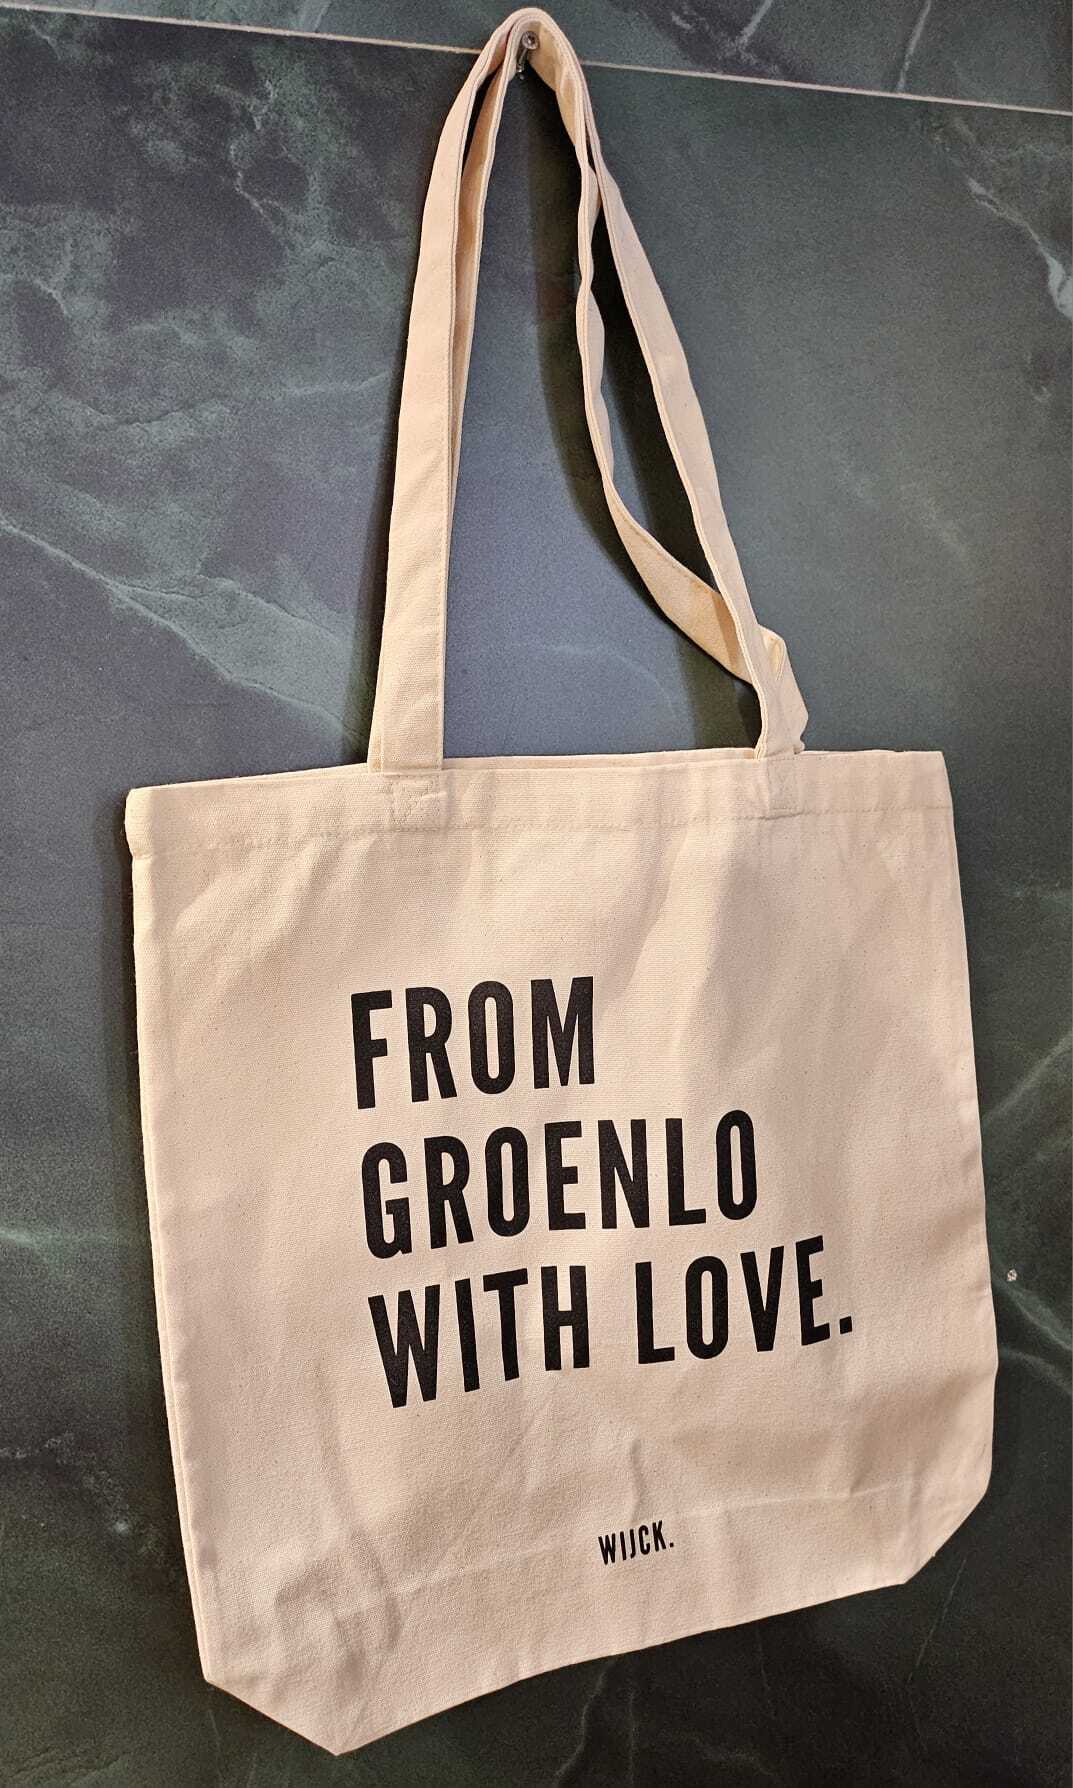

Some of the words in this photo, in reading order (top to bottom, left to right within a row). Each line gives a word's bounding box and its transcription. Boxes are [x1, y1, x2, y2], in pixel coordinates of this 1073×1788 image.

[351, 976, 595, 1110] FROM
[361, 1109, 758, 1260] GROENLO
[367, 1265, 590, 1409] WITH
[635, 1234, 854, 1366] LOVE.
[597, 1519, 676, 1566] WIJCK.
